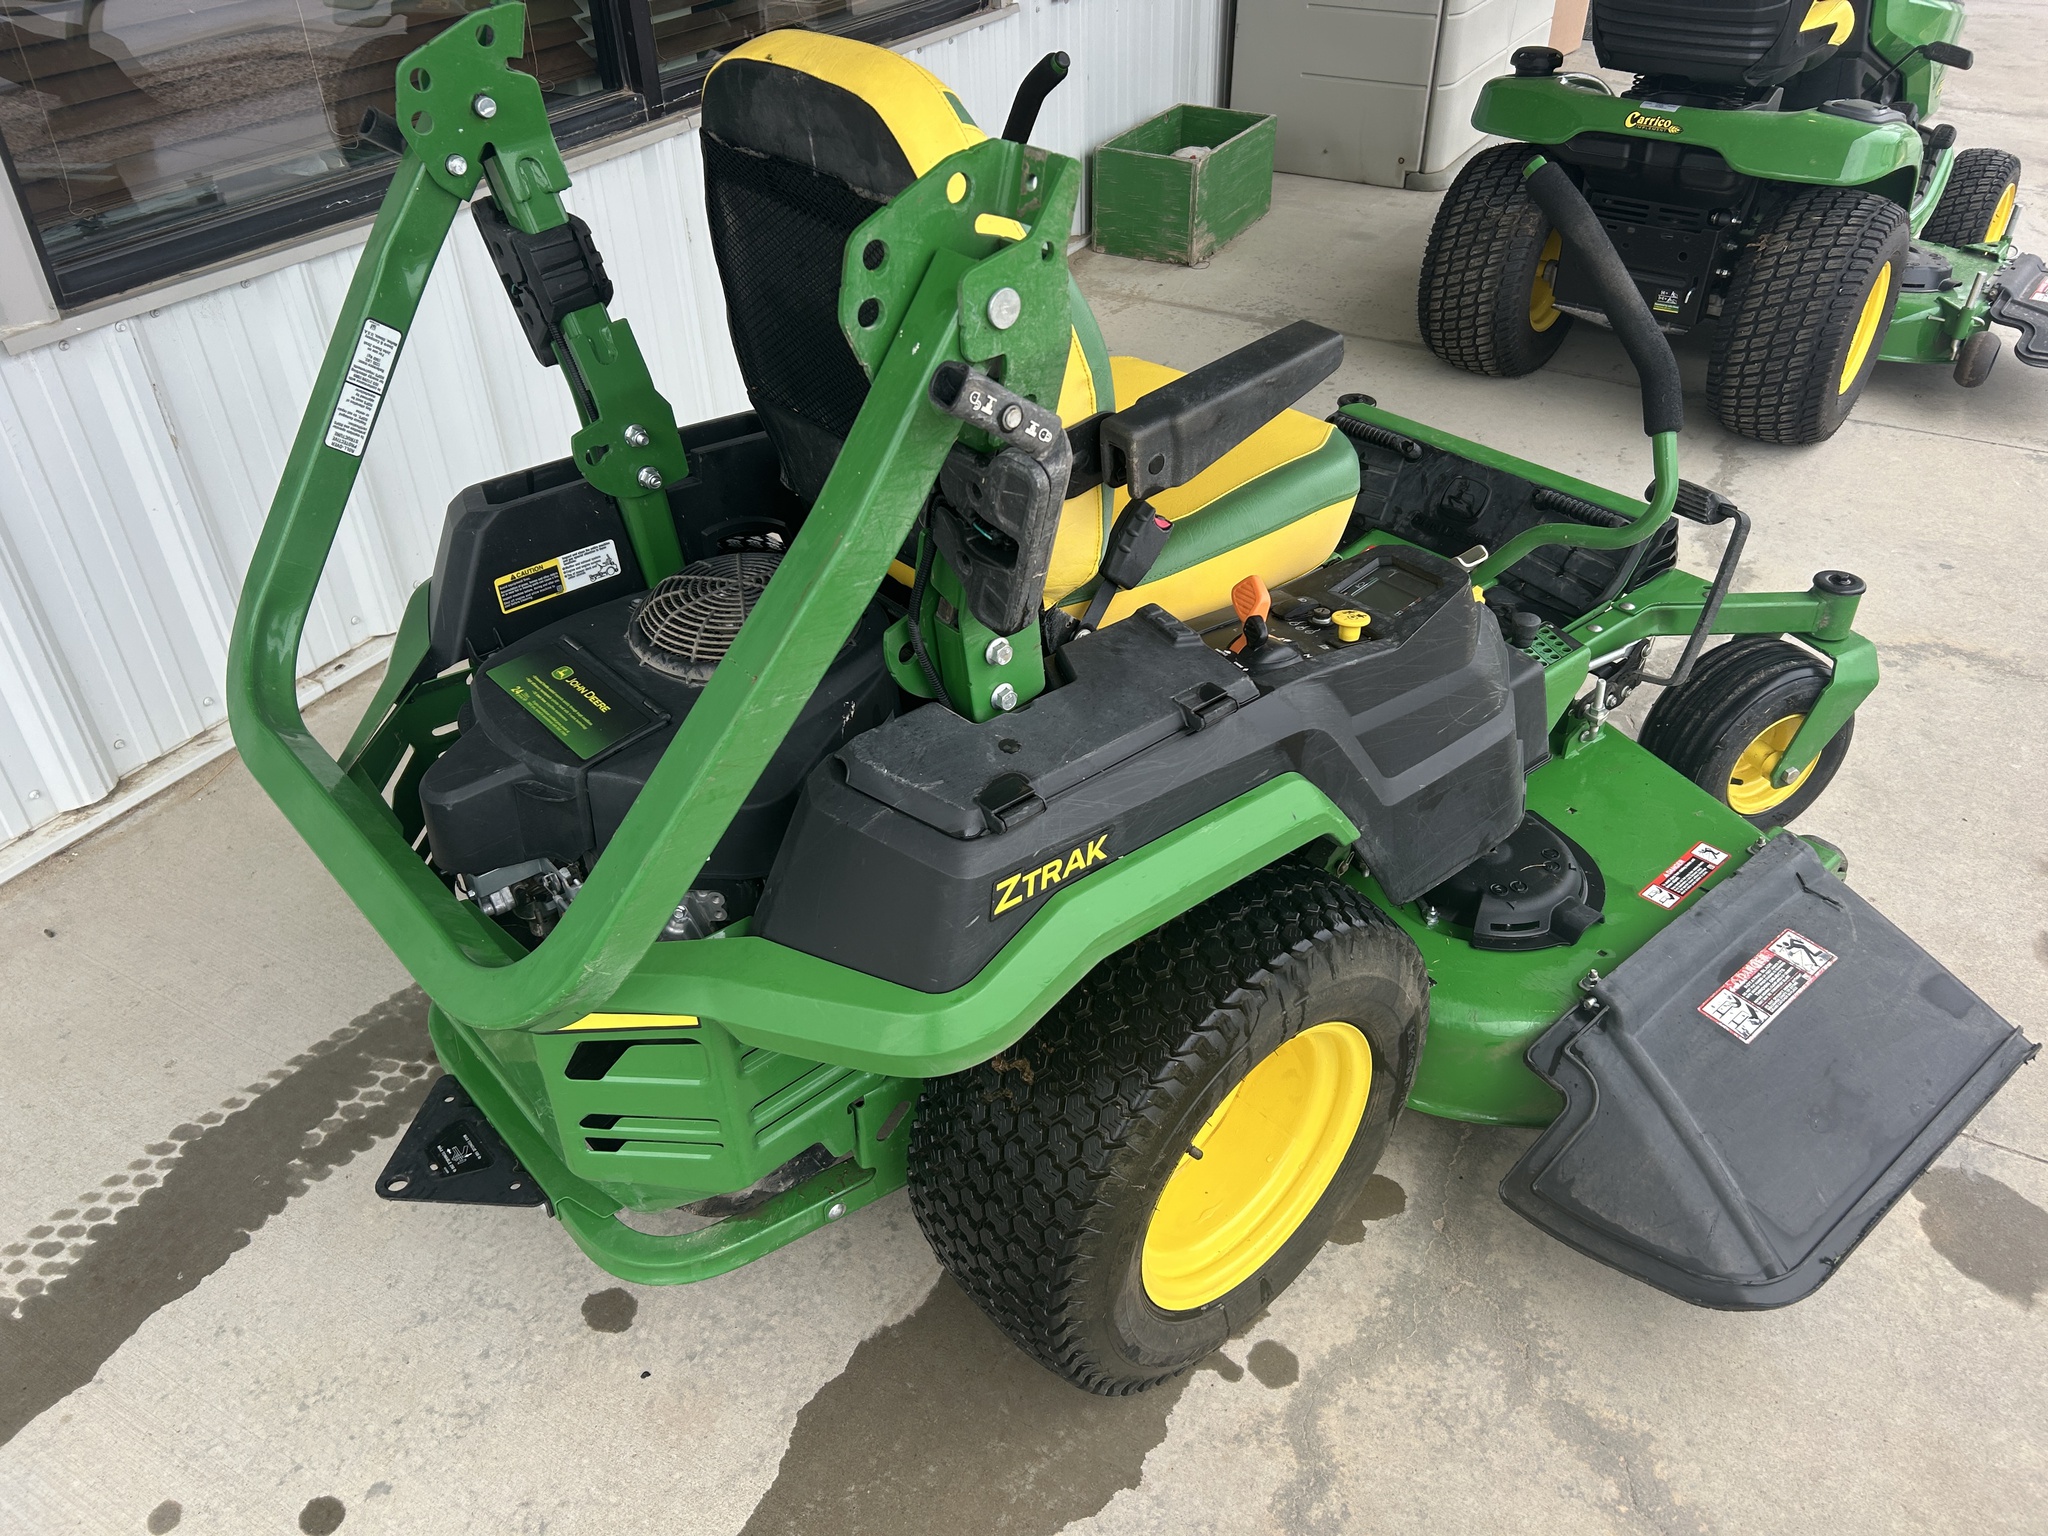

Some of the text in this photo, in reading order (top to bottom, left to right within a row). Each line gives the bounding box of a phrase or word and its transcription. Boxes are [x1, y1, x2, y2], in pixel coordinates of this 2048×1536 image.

[1625, 111, 1672, 128] Carrico
[331, 436, 357, 448] PROTECTIVE
[515, 564, 544, 579] CAUTION
[565, 677, 589, 697] JOHN
[583, 690, 611, 713] DEERE
[993, 833, 1108, 915] ZTRAK
